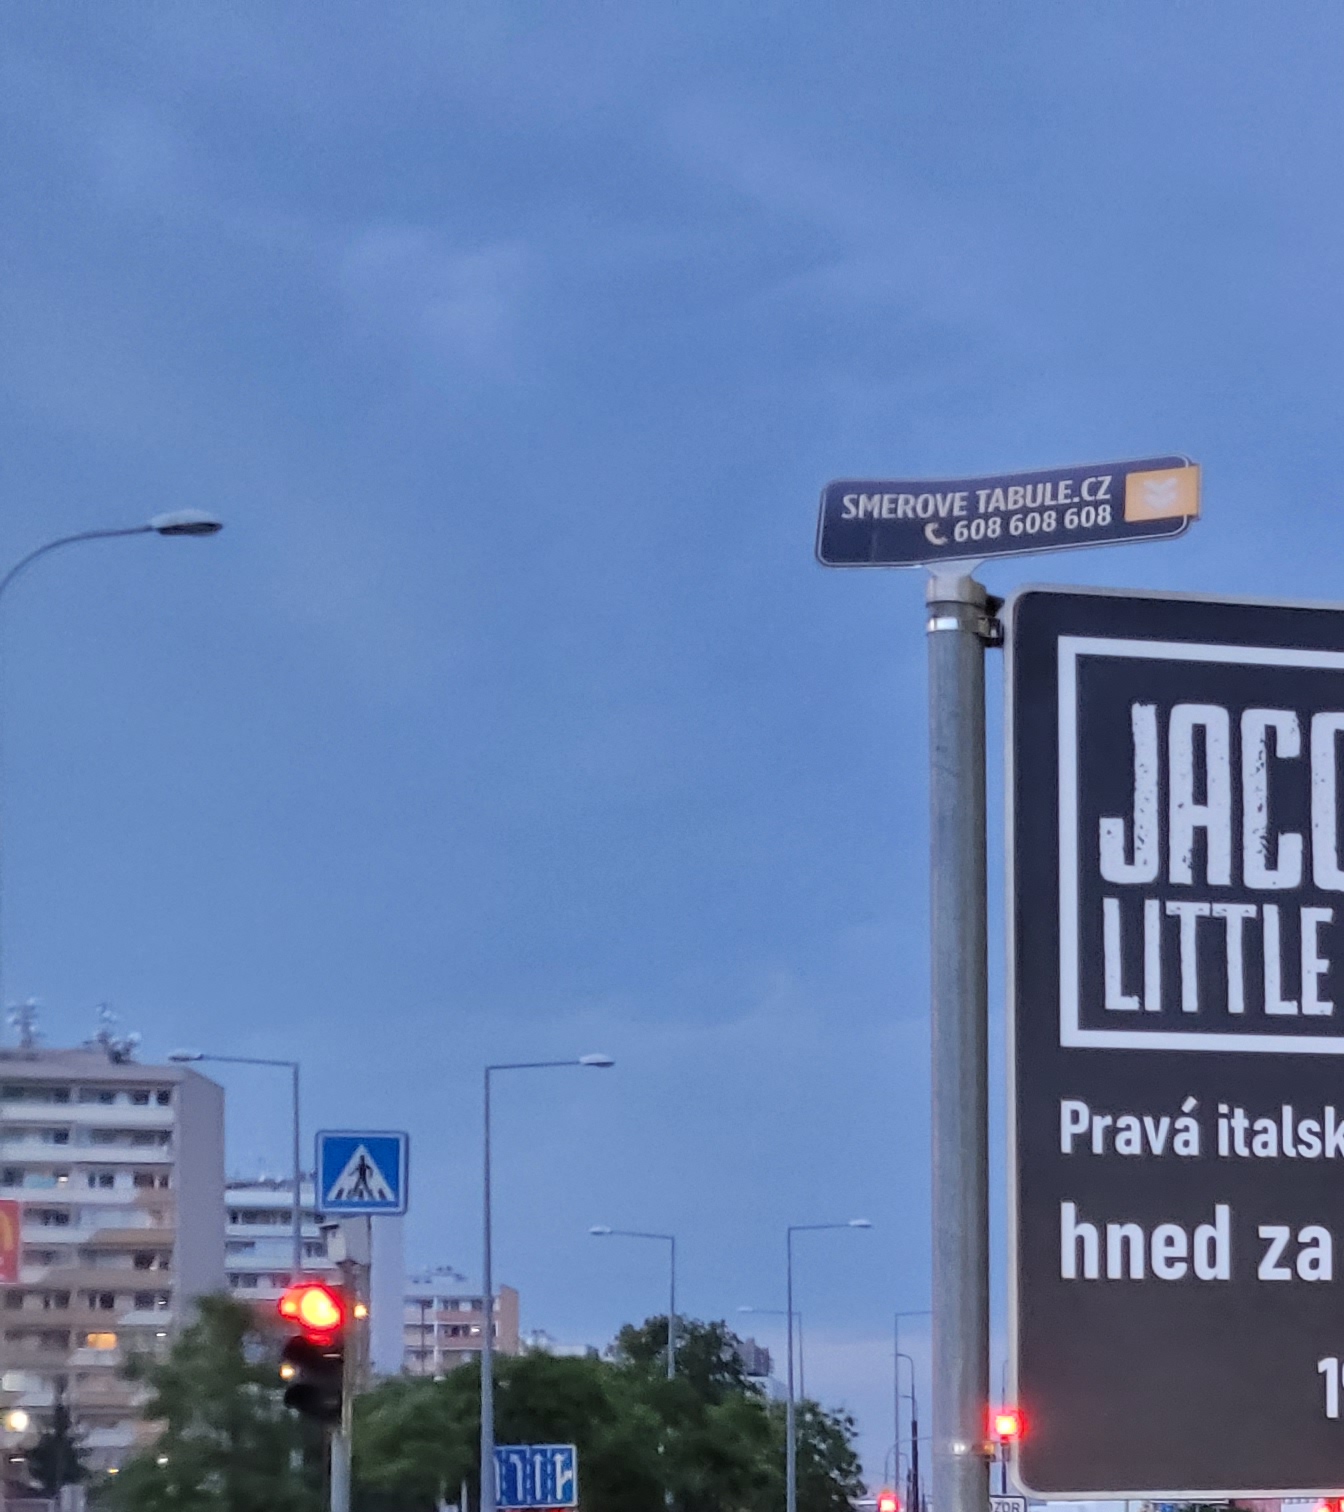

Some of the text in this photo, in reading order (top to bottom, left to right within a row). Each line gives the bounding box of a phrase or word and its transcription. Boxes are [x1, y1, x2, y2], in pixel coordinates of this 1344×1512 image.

[953, 504, 1113, 543] 608 608 608
[975, 475, 1113, 514] TABULE.CZ
[1103, 897, 1335, 1016] LITTLE
[1060, 1096, 1201, 1156] Pravá
[1060, 1201, 1231, 1281] hned
[1257, 1225, 1333, 1282] za
